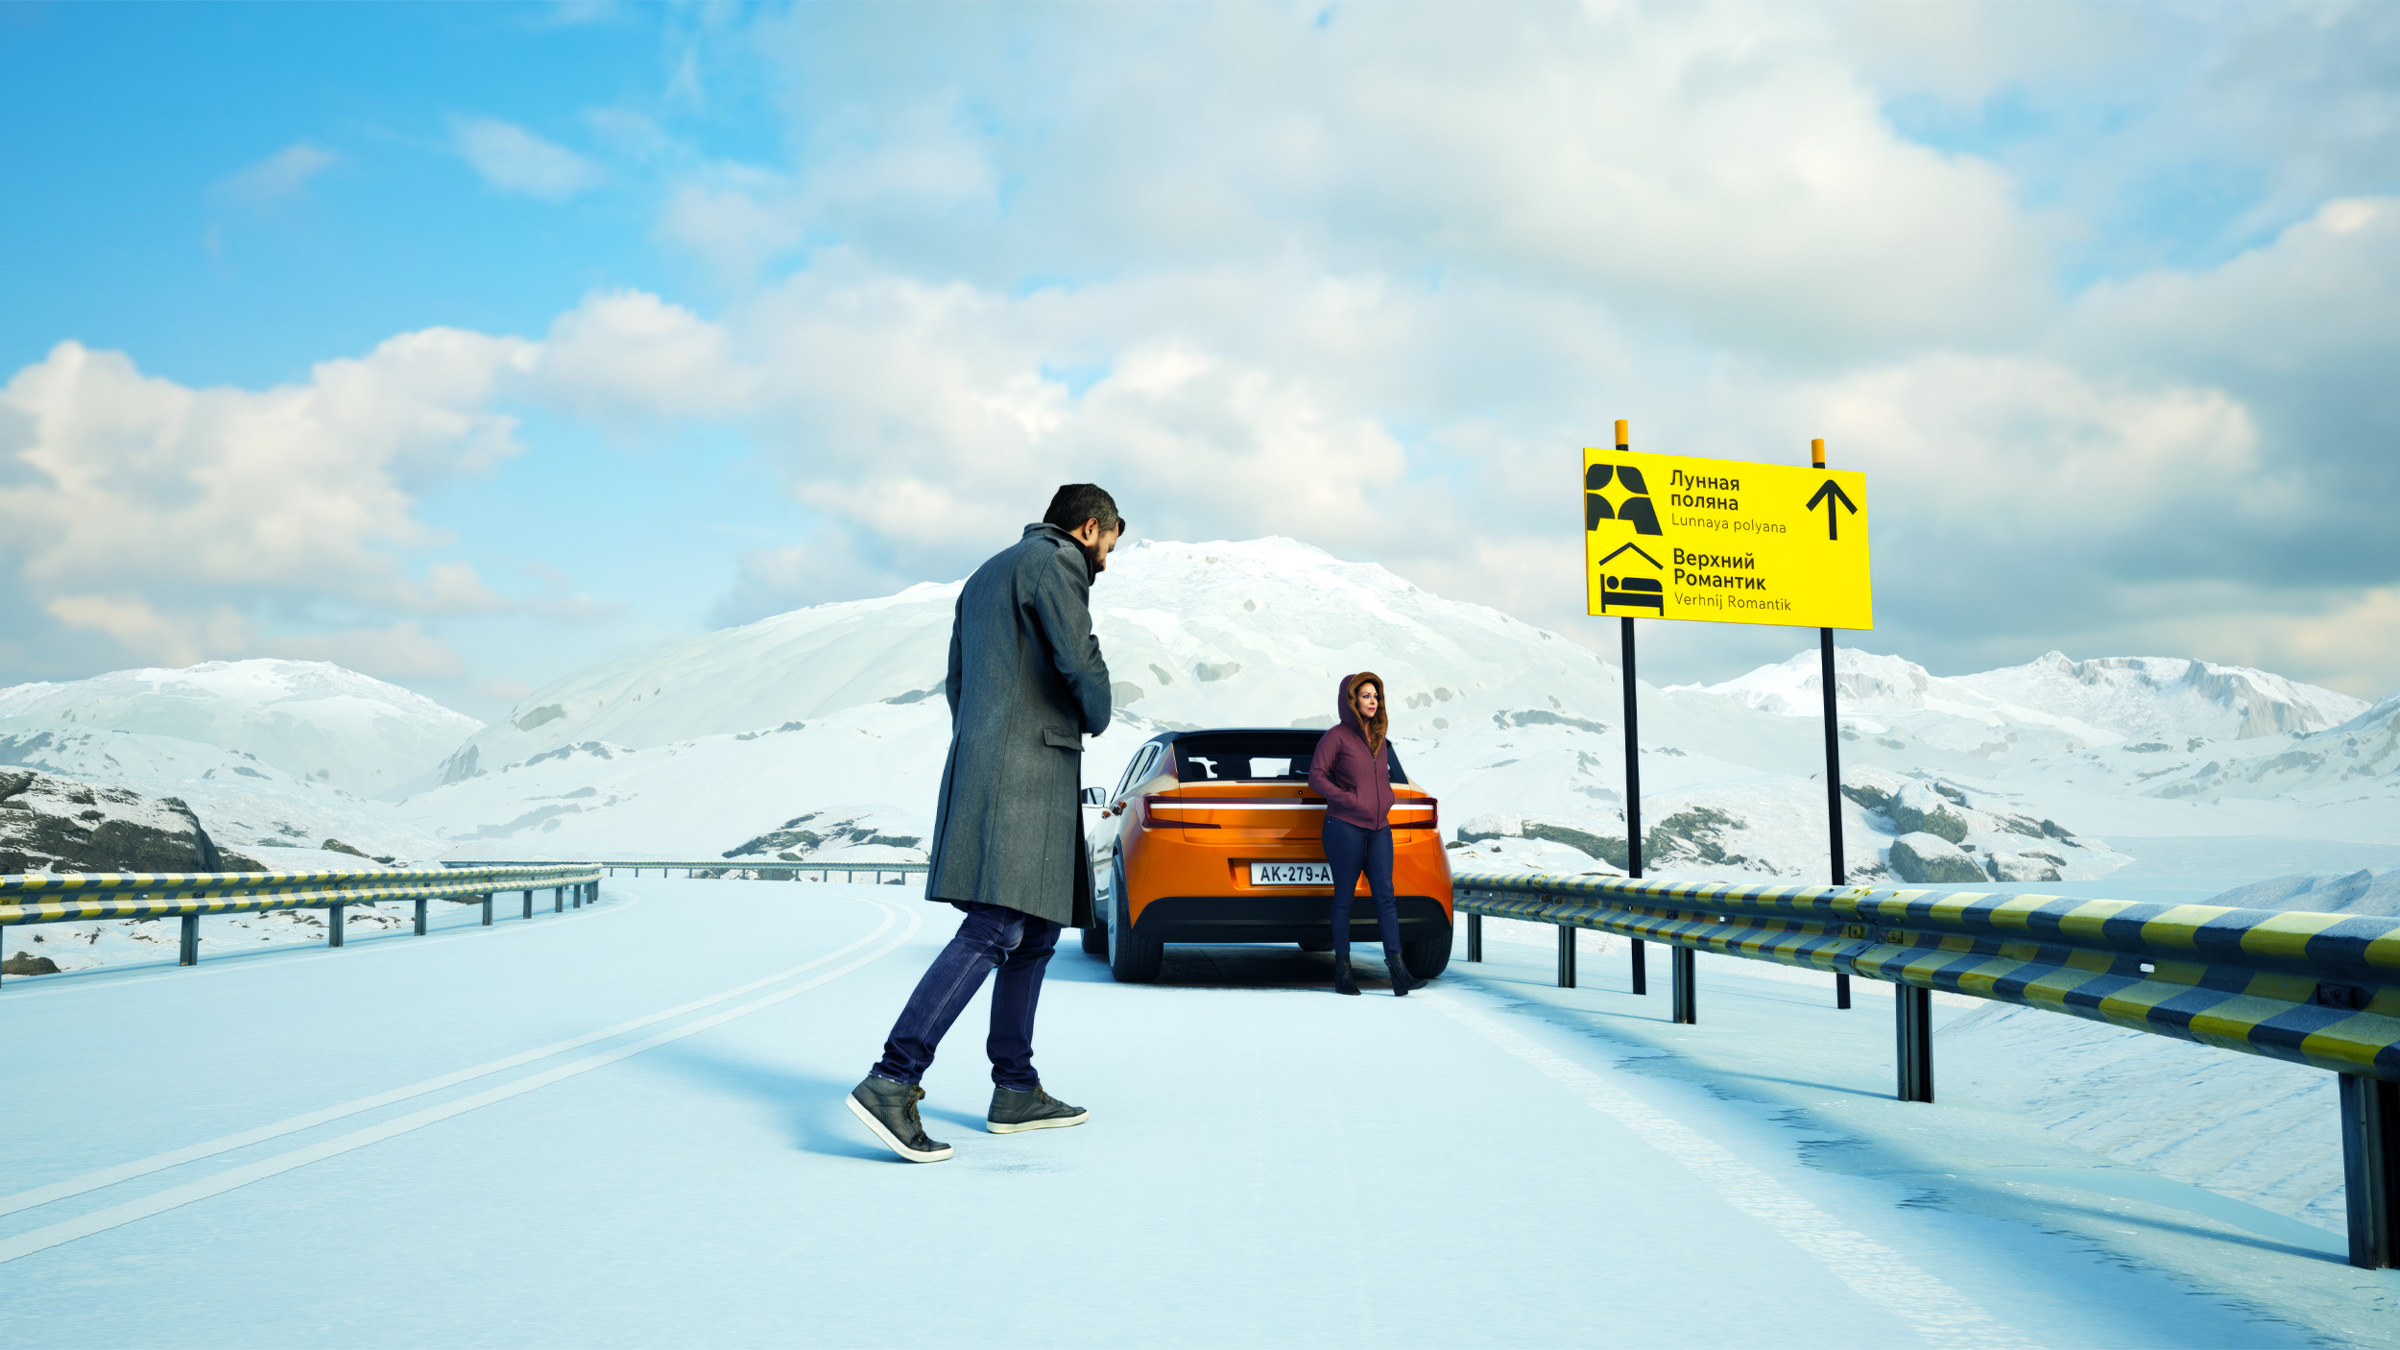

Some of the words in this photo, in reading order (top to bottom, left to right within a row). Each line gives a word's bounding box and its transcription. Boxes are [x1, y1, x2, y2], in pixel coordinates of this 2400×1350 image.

[1669, 469, 1740, 491] Лунная
[1671, 493, 1739, 510] поляна
[1671, 513, 1729, 530] Lunnaya
[1733, 519, 1787, 534] polyana
[1673, 547, 1755, 571] Верхний
[1674, 567, 1767, 591] Романтик
[1674, 592, 1723, 610] Verhnij
[1728, 595, 1792, 611] Romantik
[1260, 866, 1331, 882] AK-279-A
